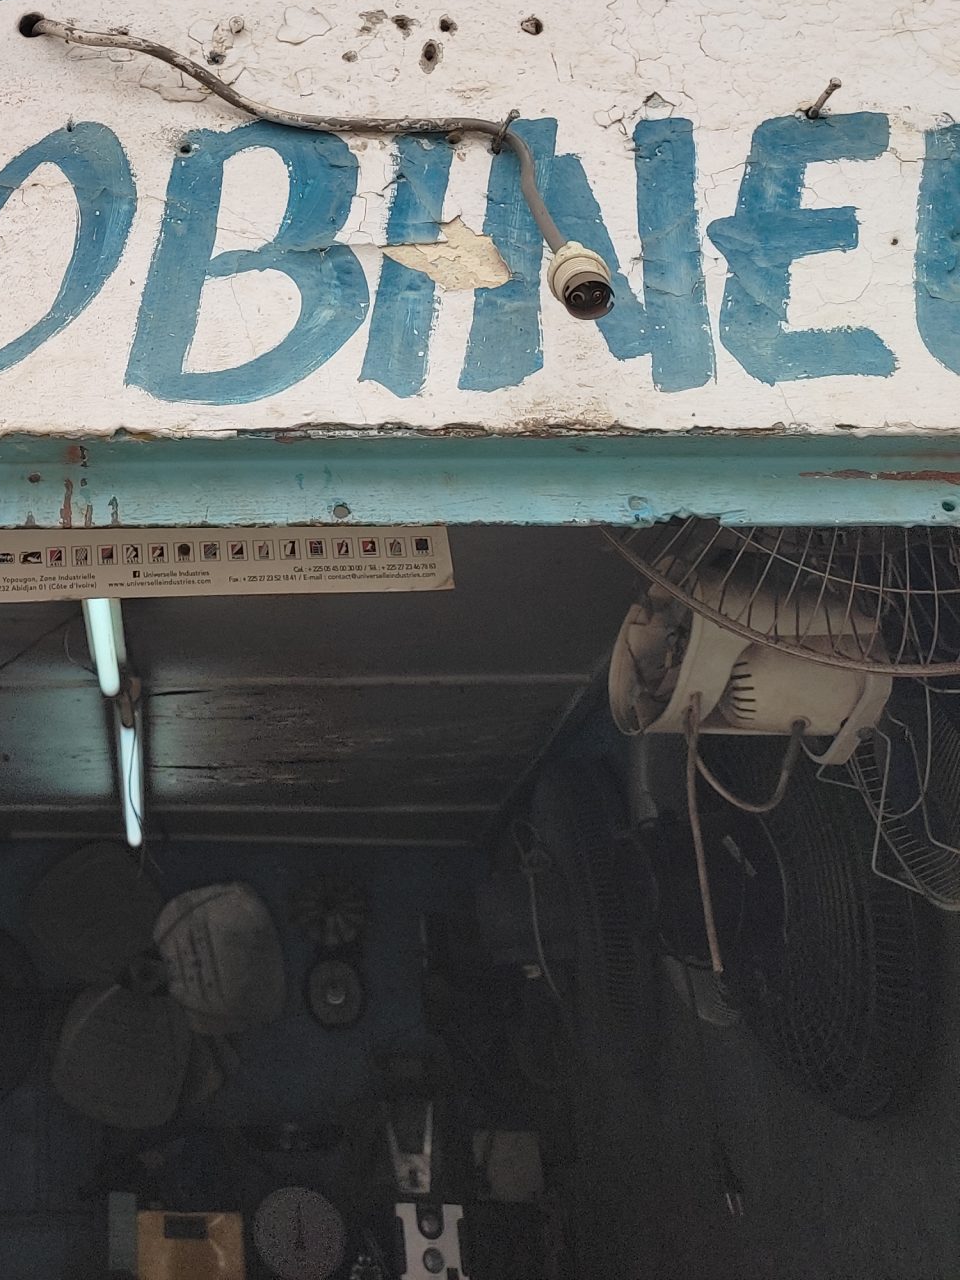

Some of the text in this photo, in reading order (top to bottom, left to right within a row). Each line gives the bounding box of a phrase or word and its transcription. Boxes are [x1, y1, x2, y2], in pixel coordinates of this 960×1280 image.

[58, 573, 96, 581] Industrielle
[143, 570, 177, 578] Universelle
[178, 569, 210, 577] Industries
[11, 584, 37, 592] Abidjan
